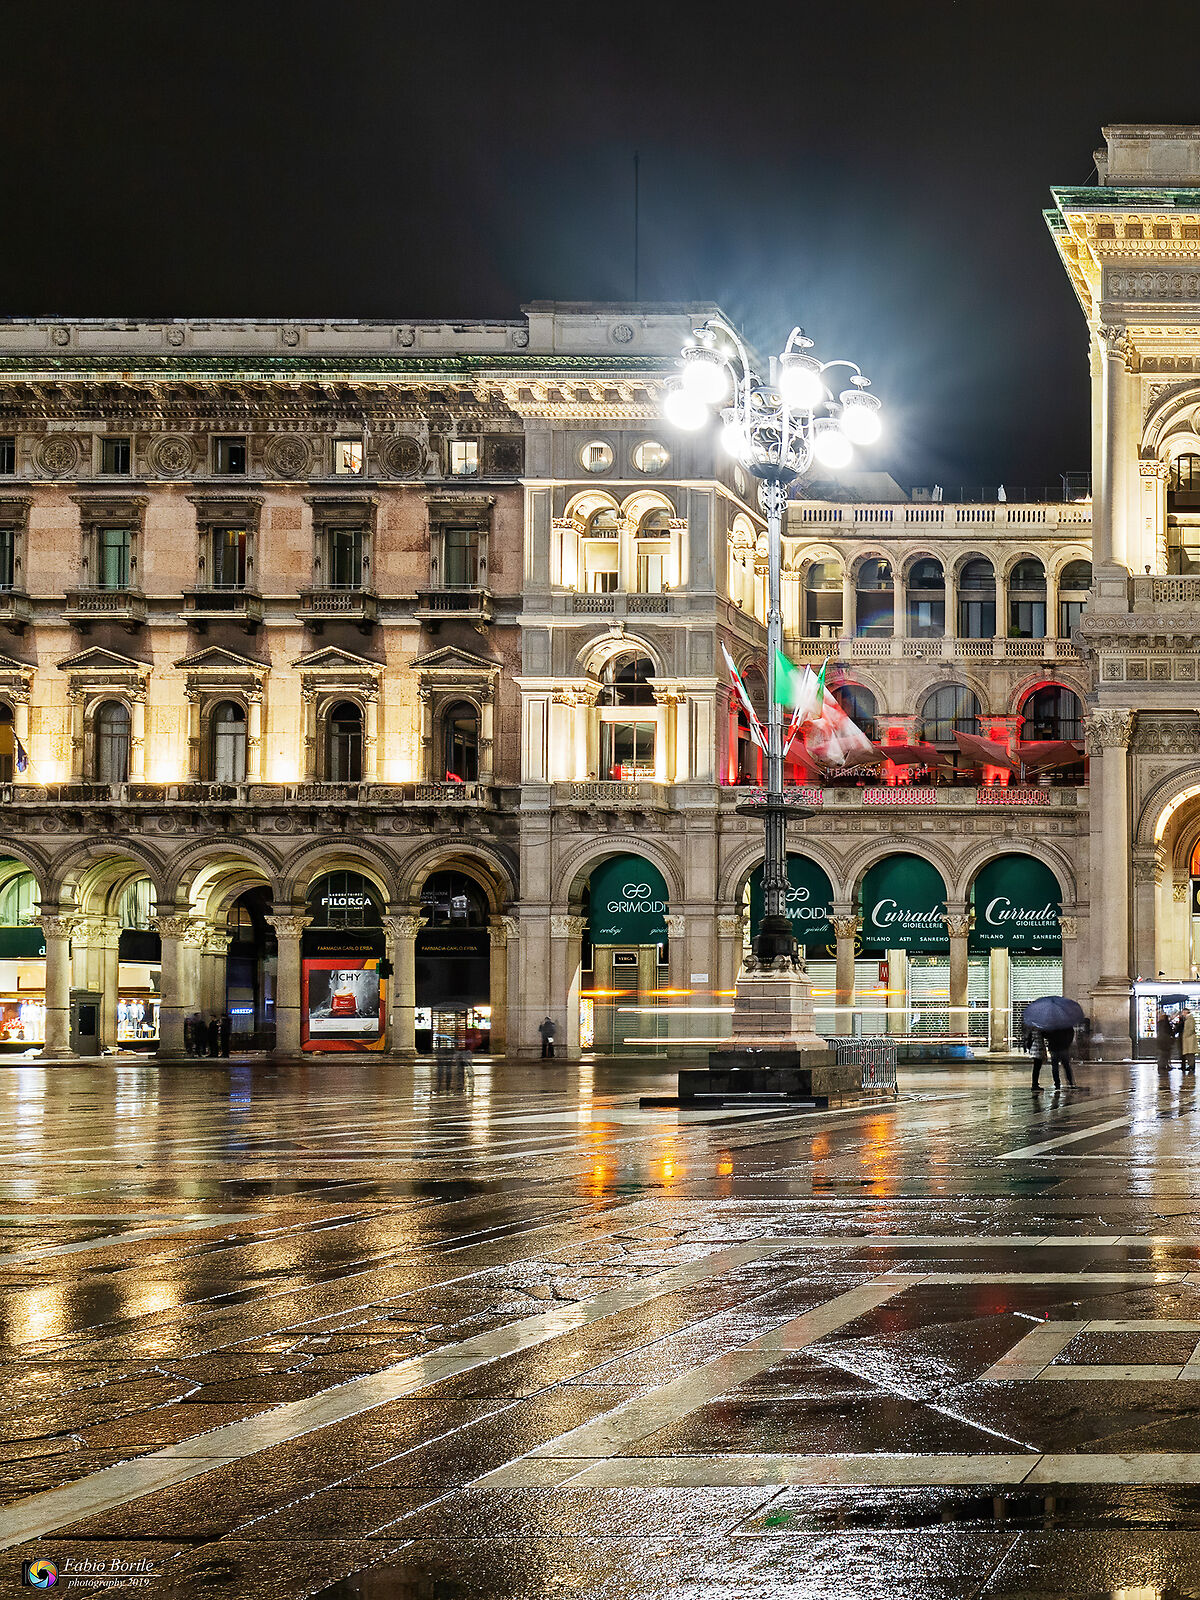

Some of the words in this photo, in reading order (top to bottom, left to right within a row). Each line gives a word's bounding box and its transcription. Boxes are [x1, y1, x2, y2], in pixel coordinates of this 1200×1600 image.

[321, 897, 372, 906] FILORGA
[607, 901, 666, 913] GRIMOLDI
[871, 899, 943, 928] Currado
[985, 896, 1057, 926] Currado
[329, 973, 361, 982] VICHY
